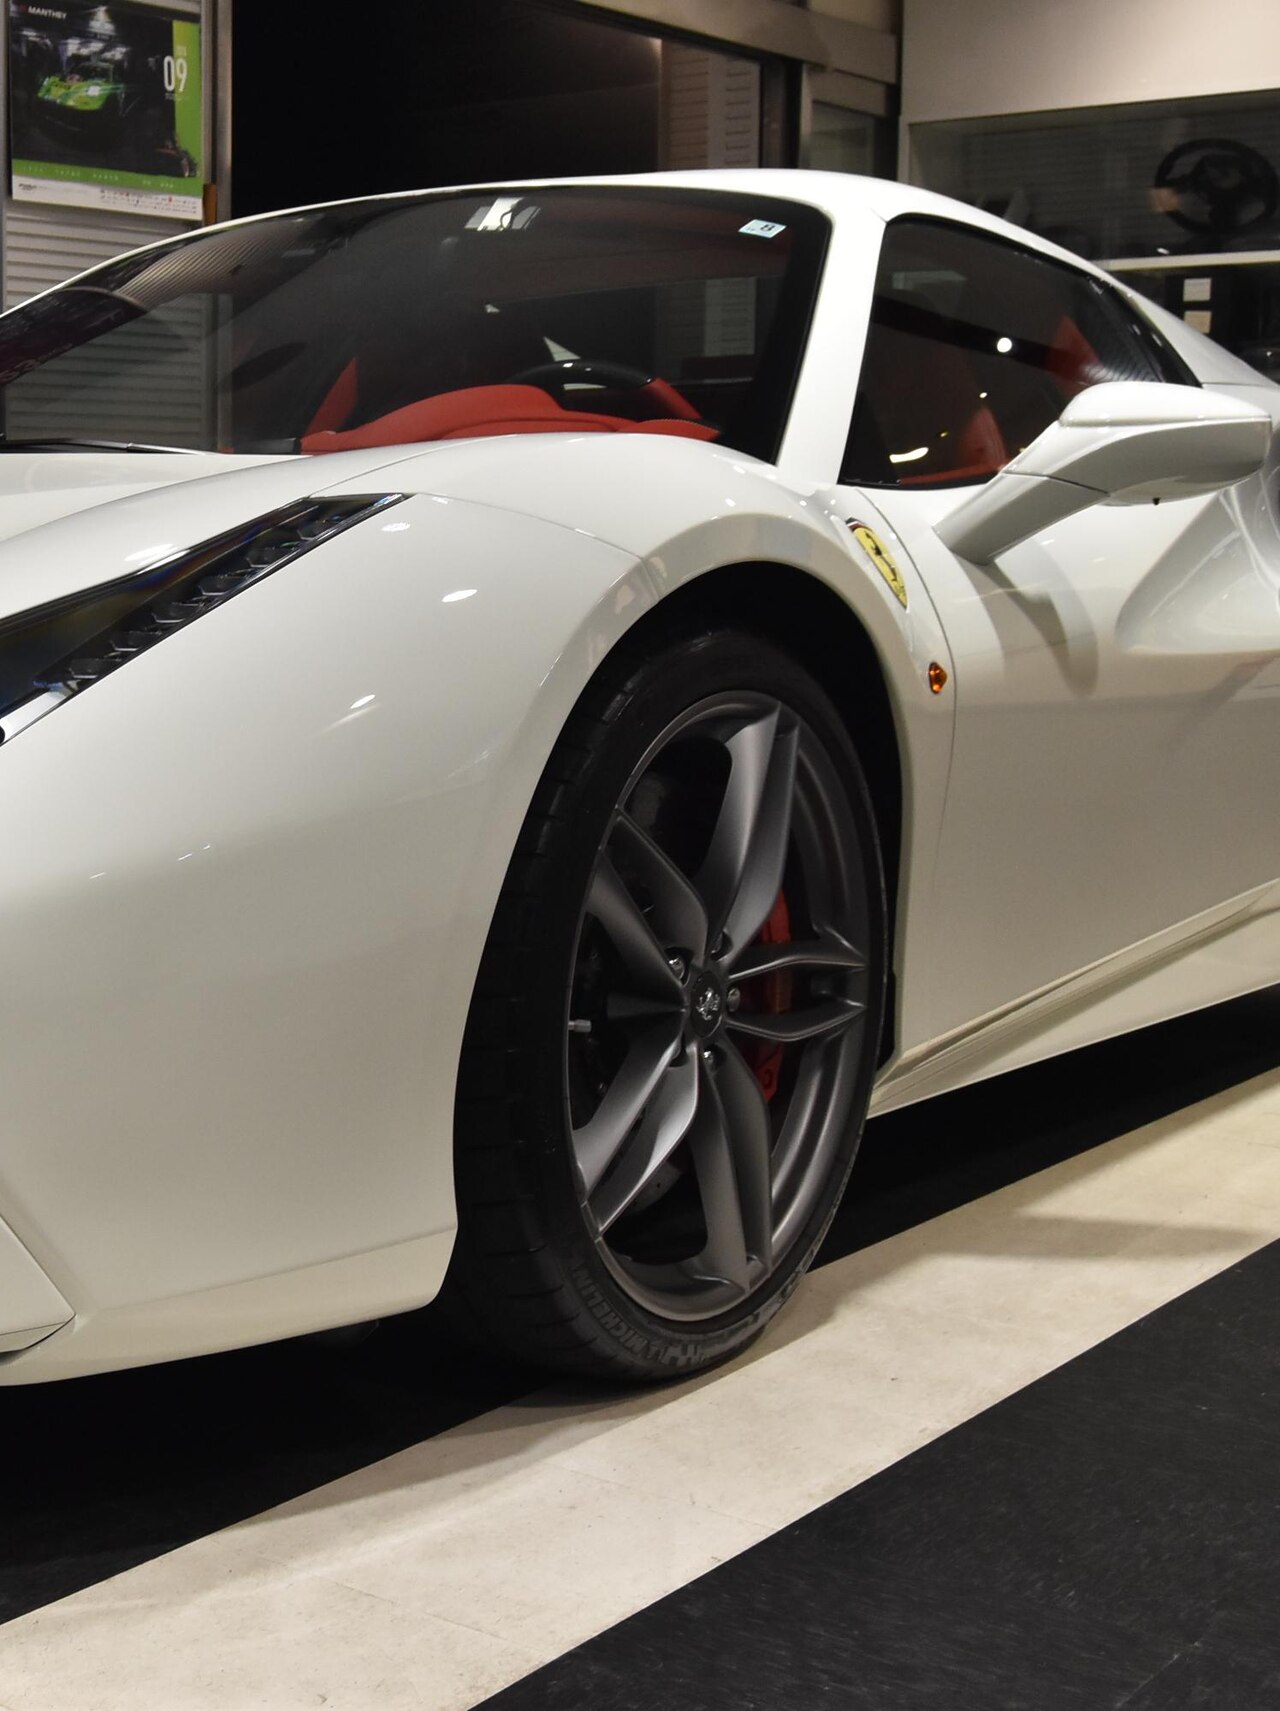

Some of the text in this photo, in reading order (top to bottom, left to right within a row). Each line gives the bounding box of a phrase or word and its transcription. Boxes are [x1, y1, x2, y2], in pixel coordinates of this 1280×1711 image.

[28, 5, 68, 20] MANTHEY
[163, 55, 188, 92] 09
[571, 1266, 650, 1354] MICHELIN
